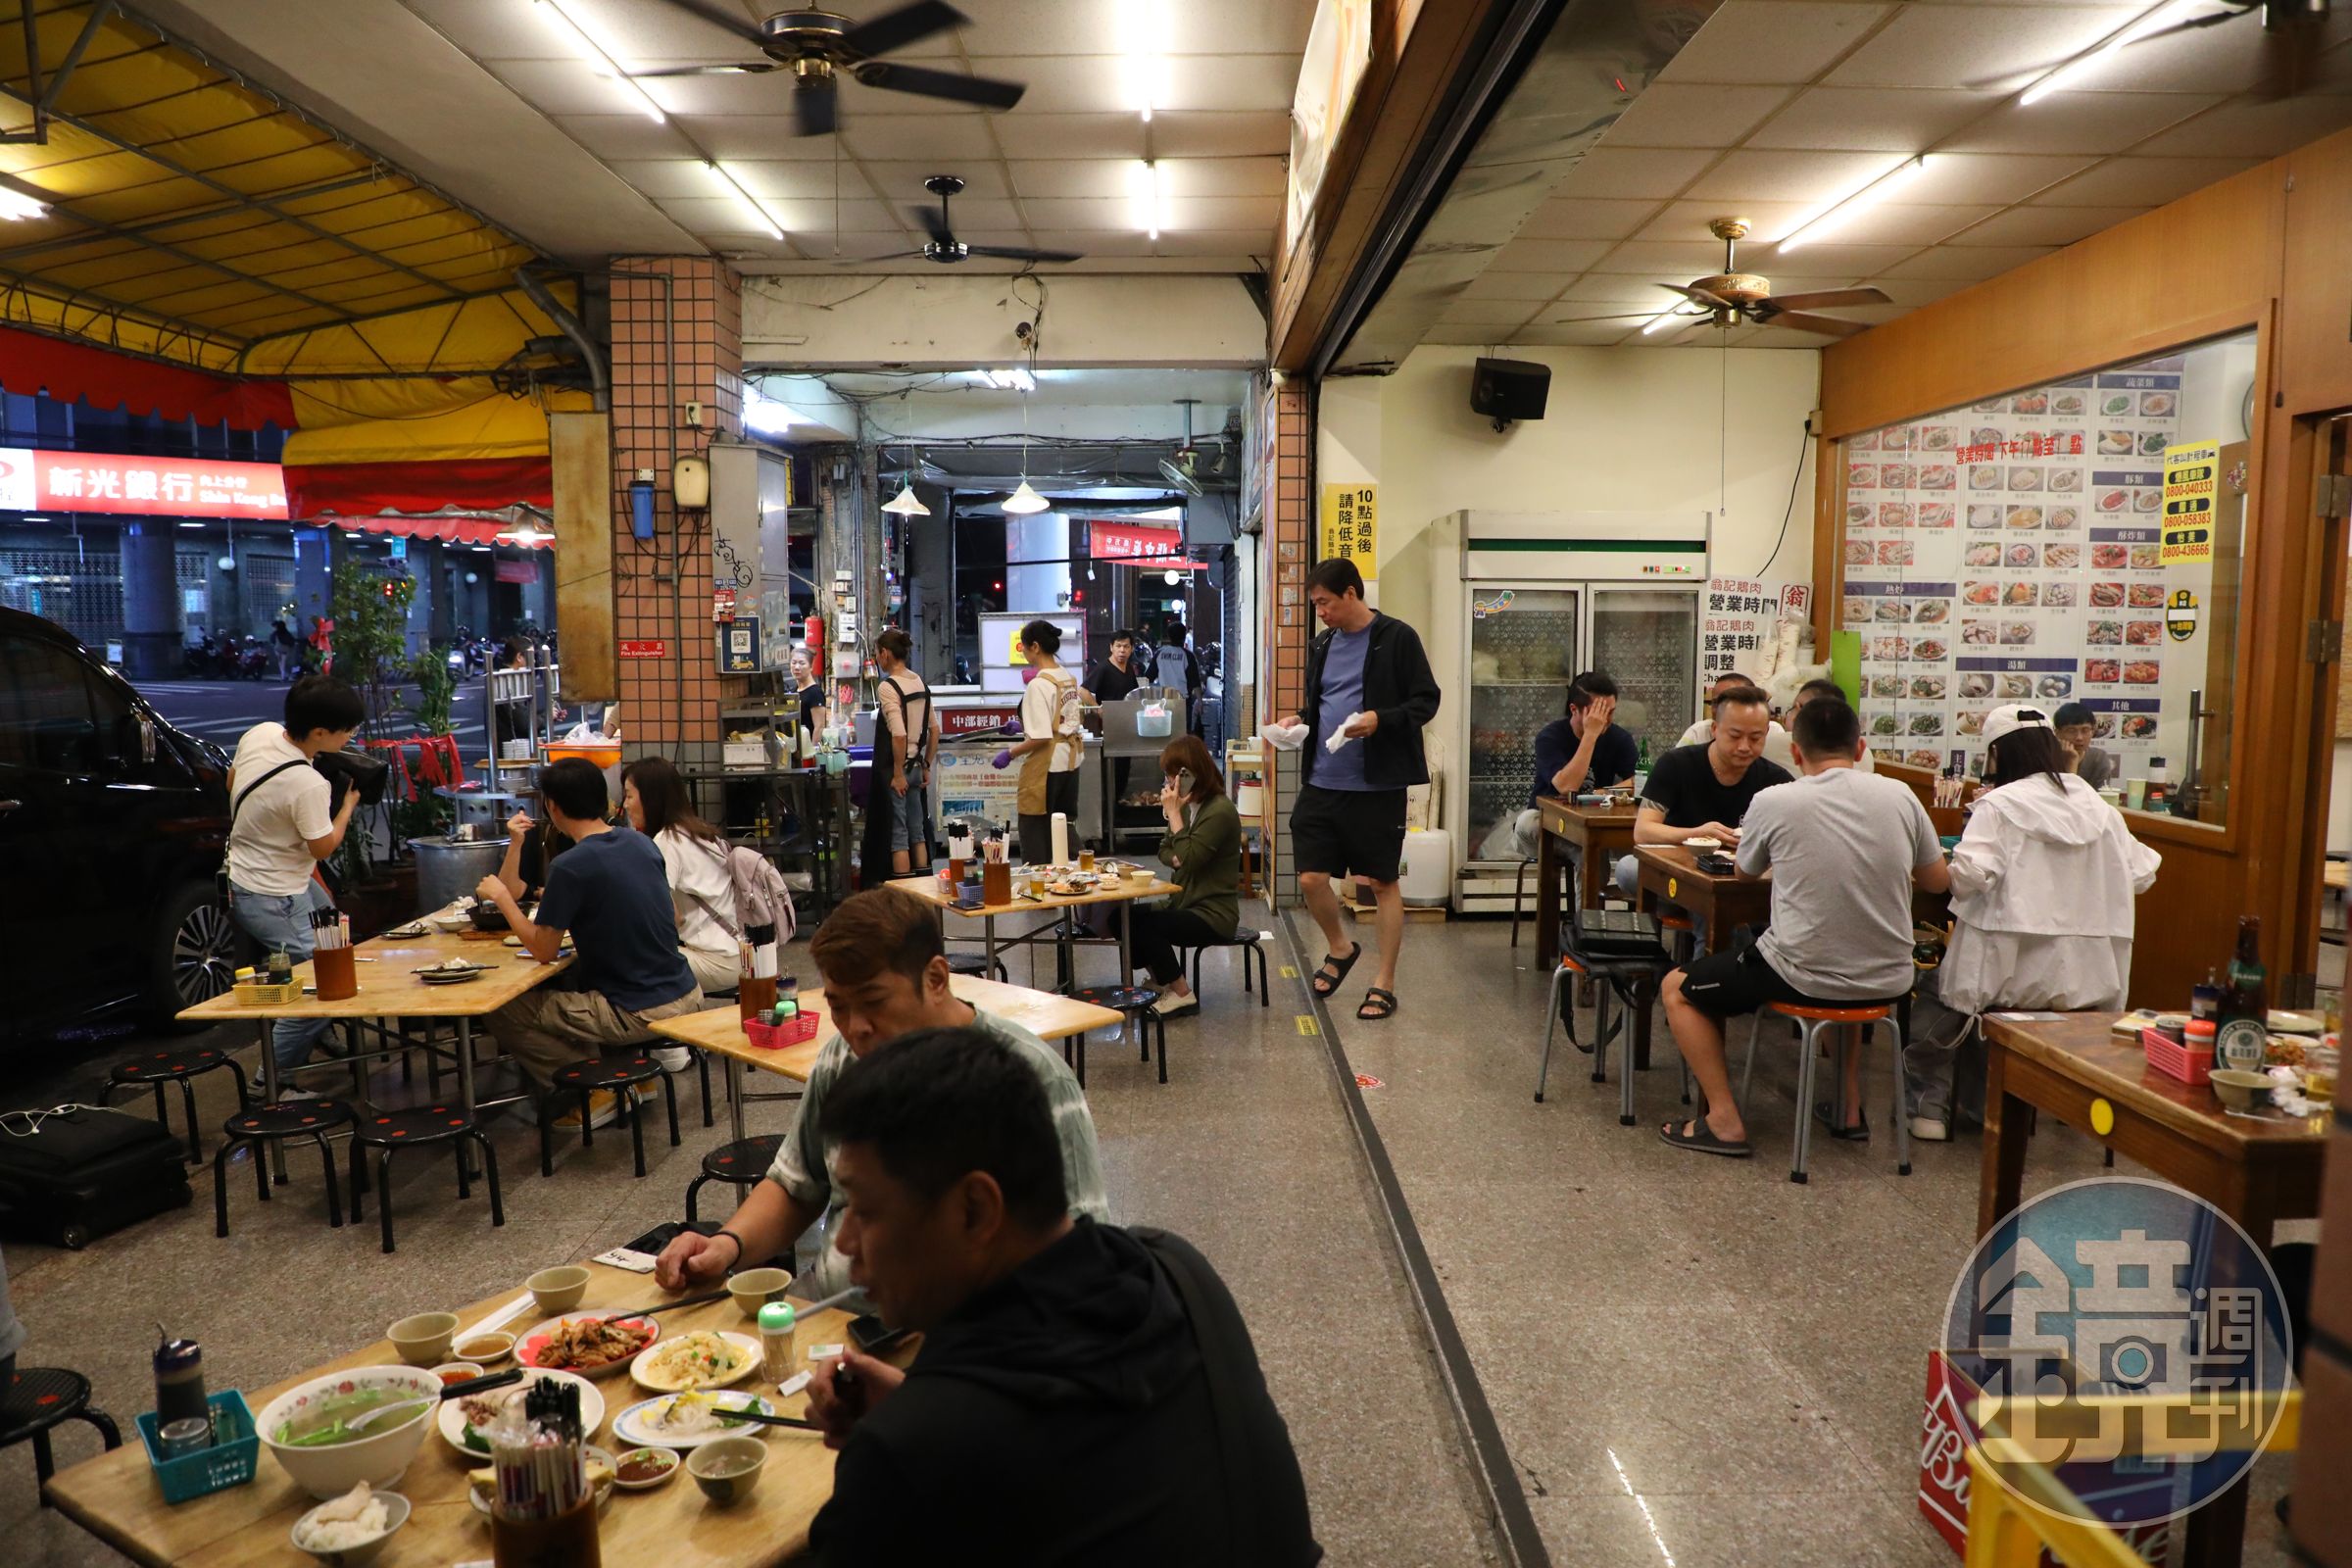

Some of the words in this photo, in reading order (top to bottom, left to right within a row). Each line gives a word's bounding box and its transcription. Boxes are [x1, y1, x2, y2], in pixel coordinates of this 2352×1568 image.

[1956, 443, 1995, 465] 營業時間
[49, 466, 193, 501] 新光銀行
[2166, 480, 2212, 498] 0800-040333
[200, 490, 231, 504] Shin
[233, 492, 268, 508] Kong
[1357, 489, 1373, 553] 10點過後
[2164, 513, 2211, 528] 0800-058383
[2163, 544, 2209, 558] 0800-436666
[1711, 578, 1762, 594] 翁記鵝肉
[1786, 586, 1805, 608] 翁
[1705, 619, 1755, 632] 翁記鵝肉
[1705, 634, 1760, 652] 營業時
[1704, 654, 1735, 671] 調整
[2007, 660, 2027, 670] 湯類
[2112, 701, 2130, 710] 其他
